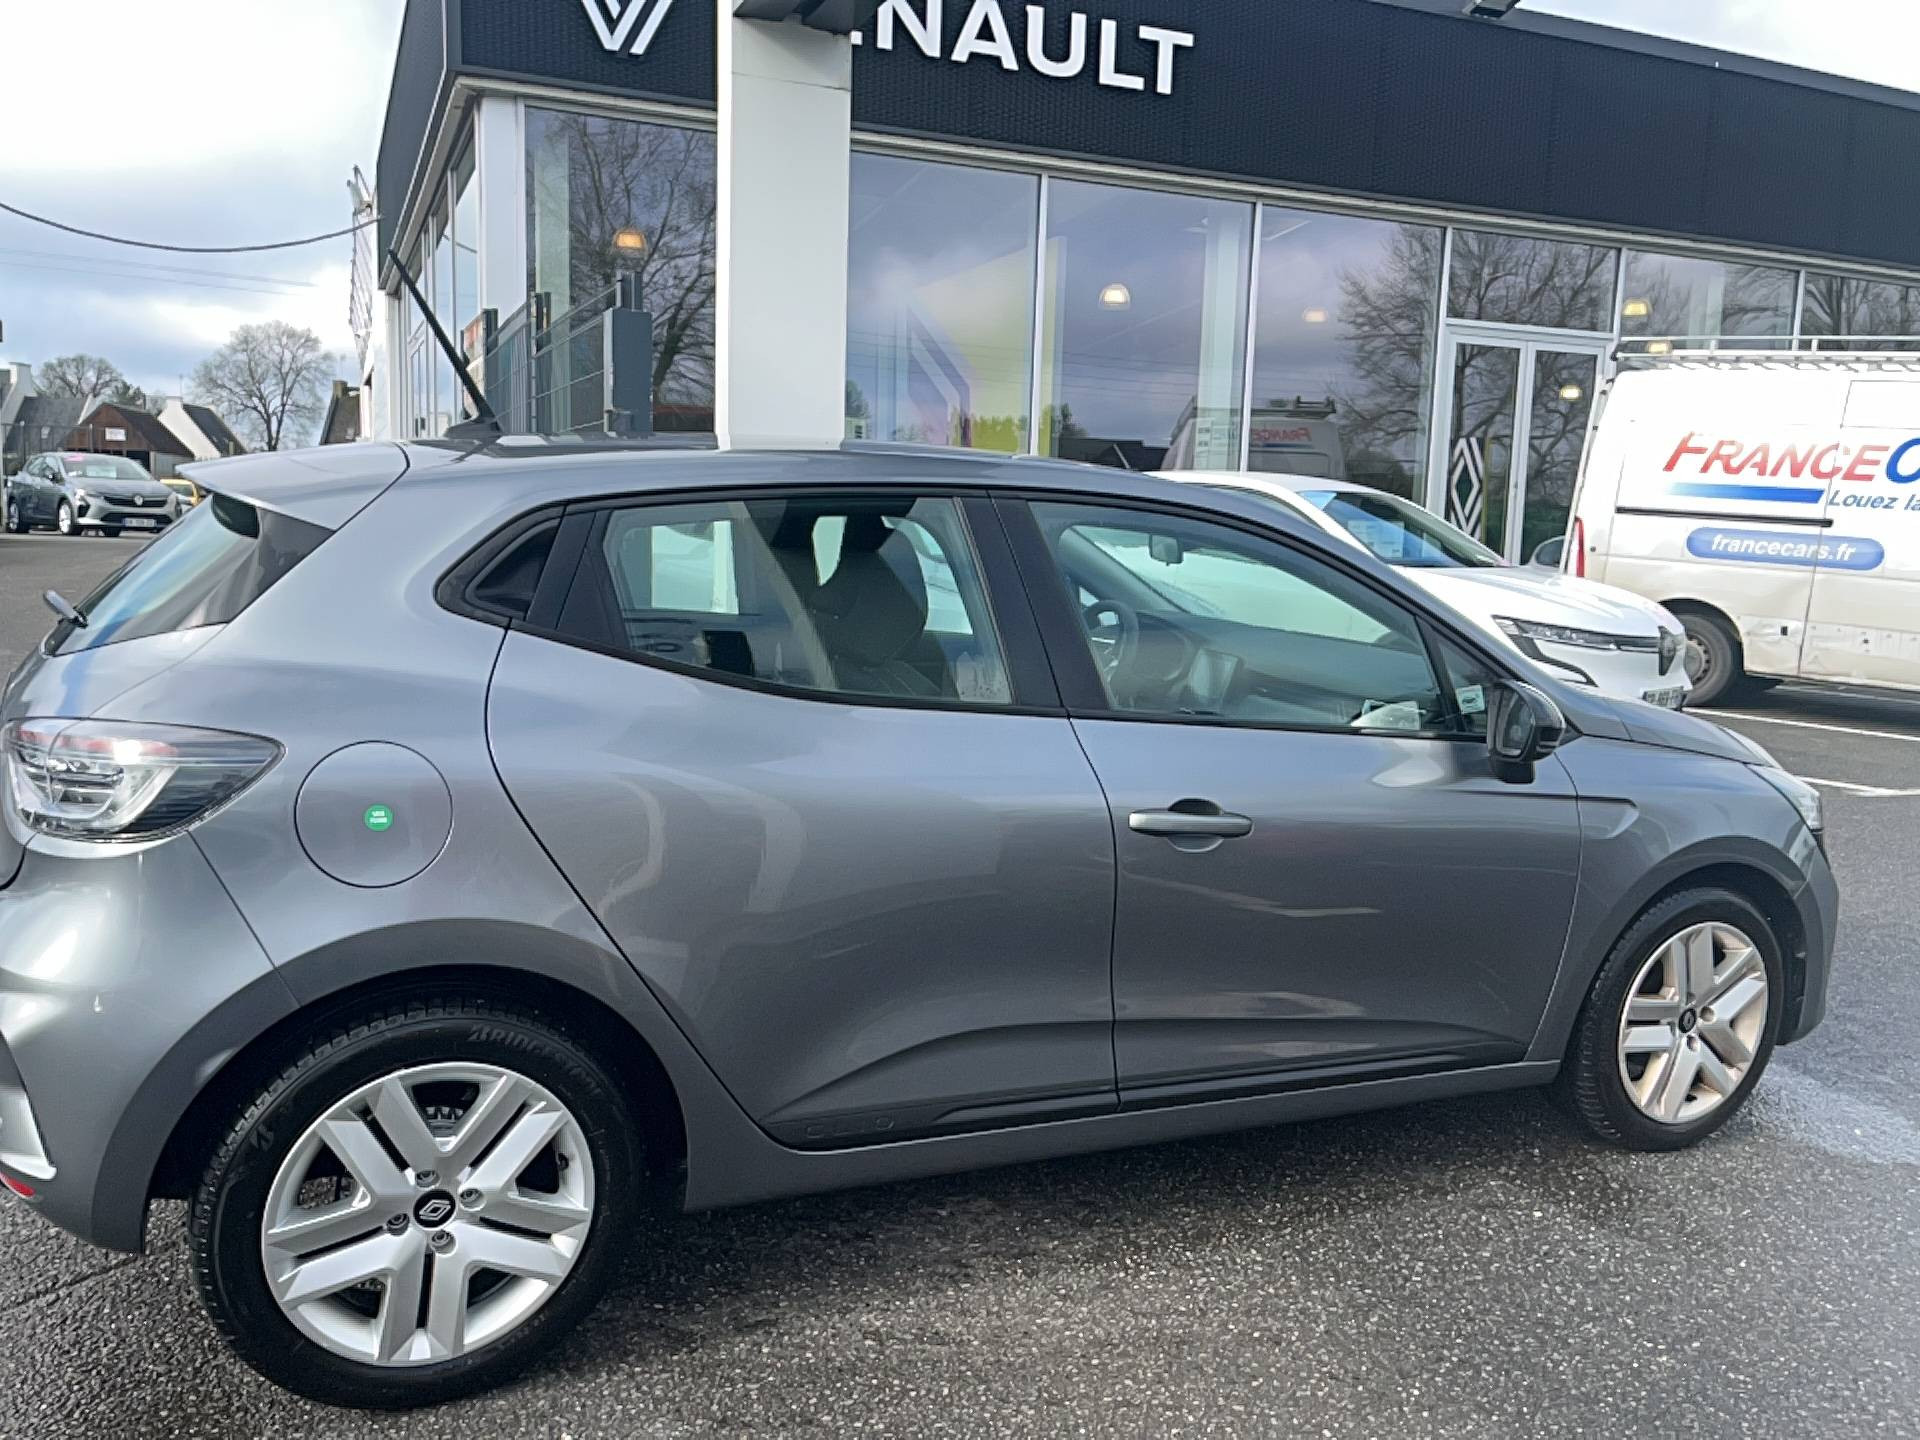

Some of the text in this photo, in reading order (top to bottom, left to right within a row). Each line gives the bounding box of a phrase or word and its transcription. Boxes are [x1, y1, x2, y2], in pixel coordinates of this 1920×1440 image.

[849, 0, 1194, 95] NAULT
[1828, 490, 1898, 509] Louez
[1711, 534, 1857, 561] francecars.fr
